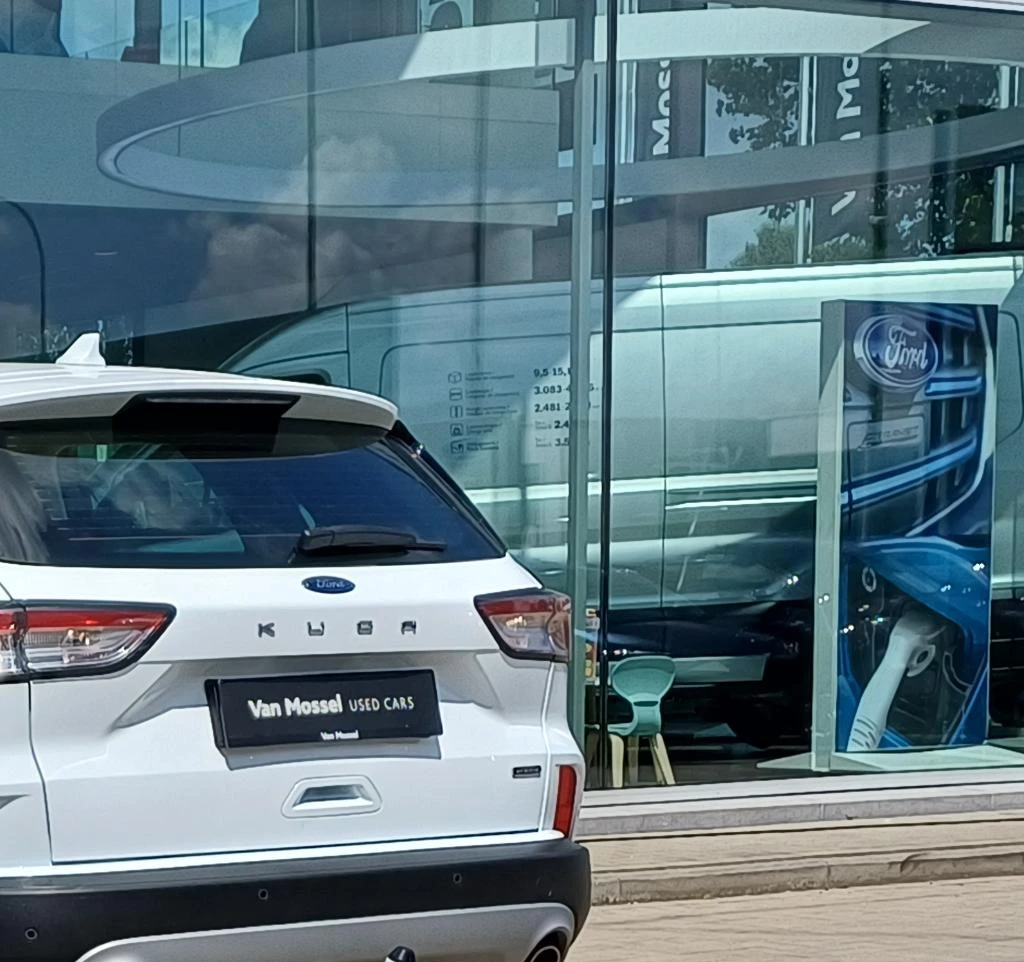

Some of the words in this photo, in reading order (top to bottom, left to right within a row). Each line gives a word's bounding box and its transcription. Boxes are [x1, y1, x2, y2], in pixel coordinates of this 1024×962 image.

[885, 325, 928, 370] Ford
[257, 619, 417, 638] KUGA
[247, 699, 282, 719] Van
[284, 693, 343, 717] Mossel
[348, 698, 380, 712] USED
[383, 696, 415, 711] CARS
